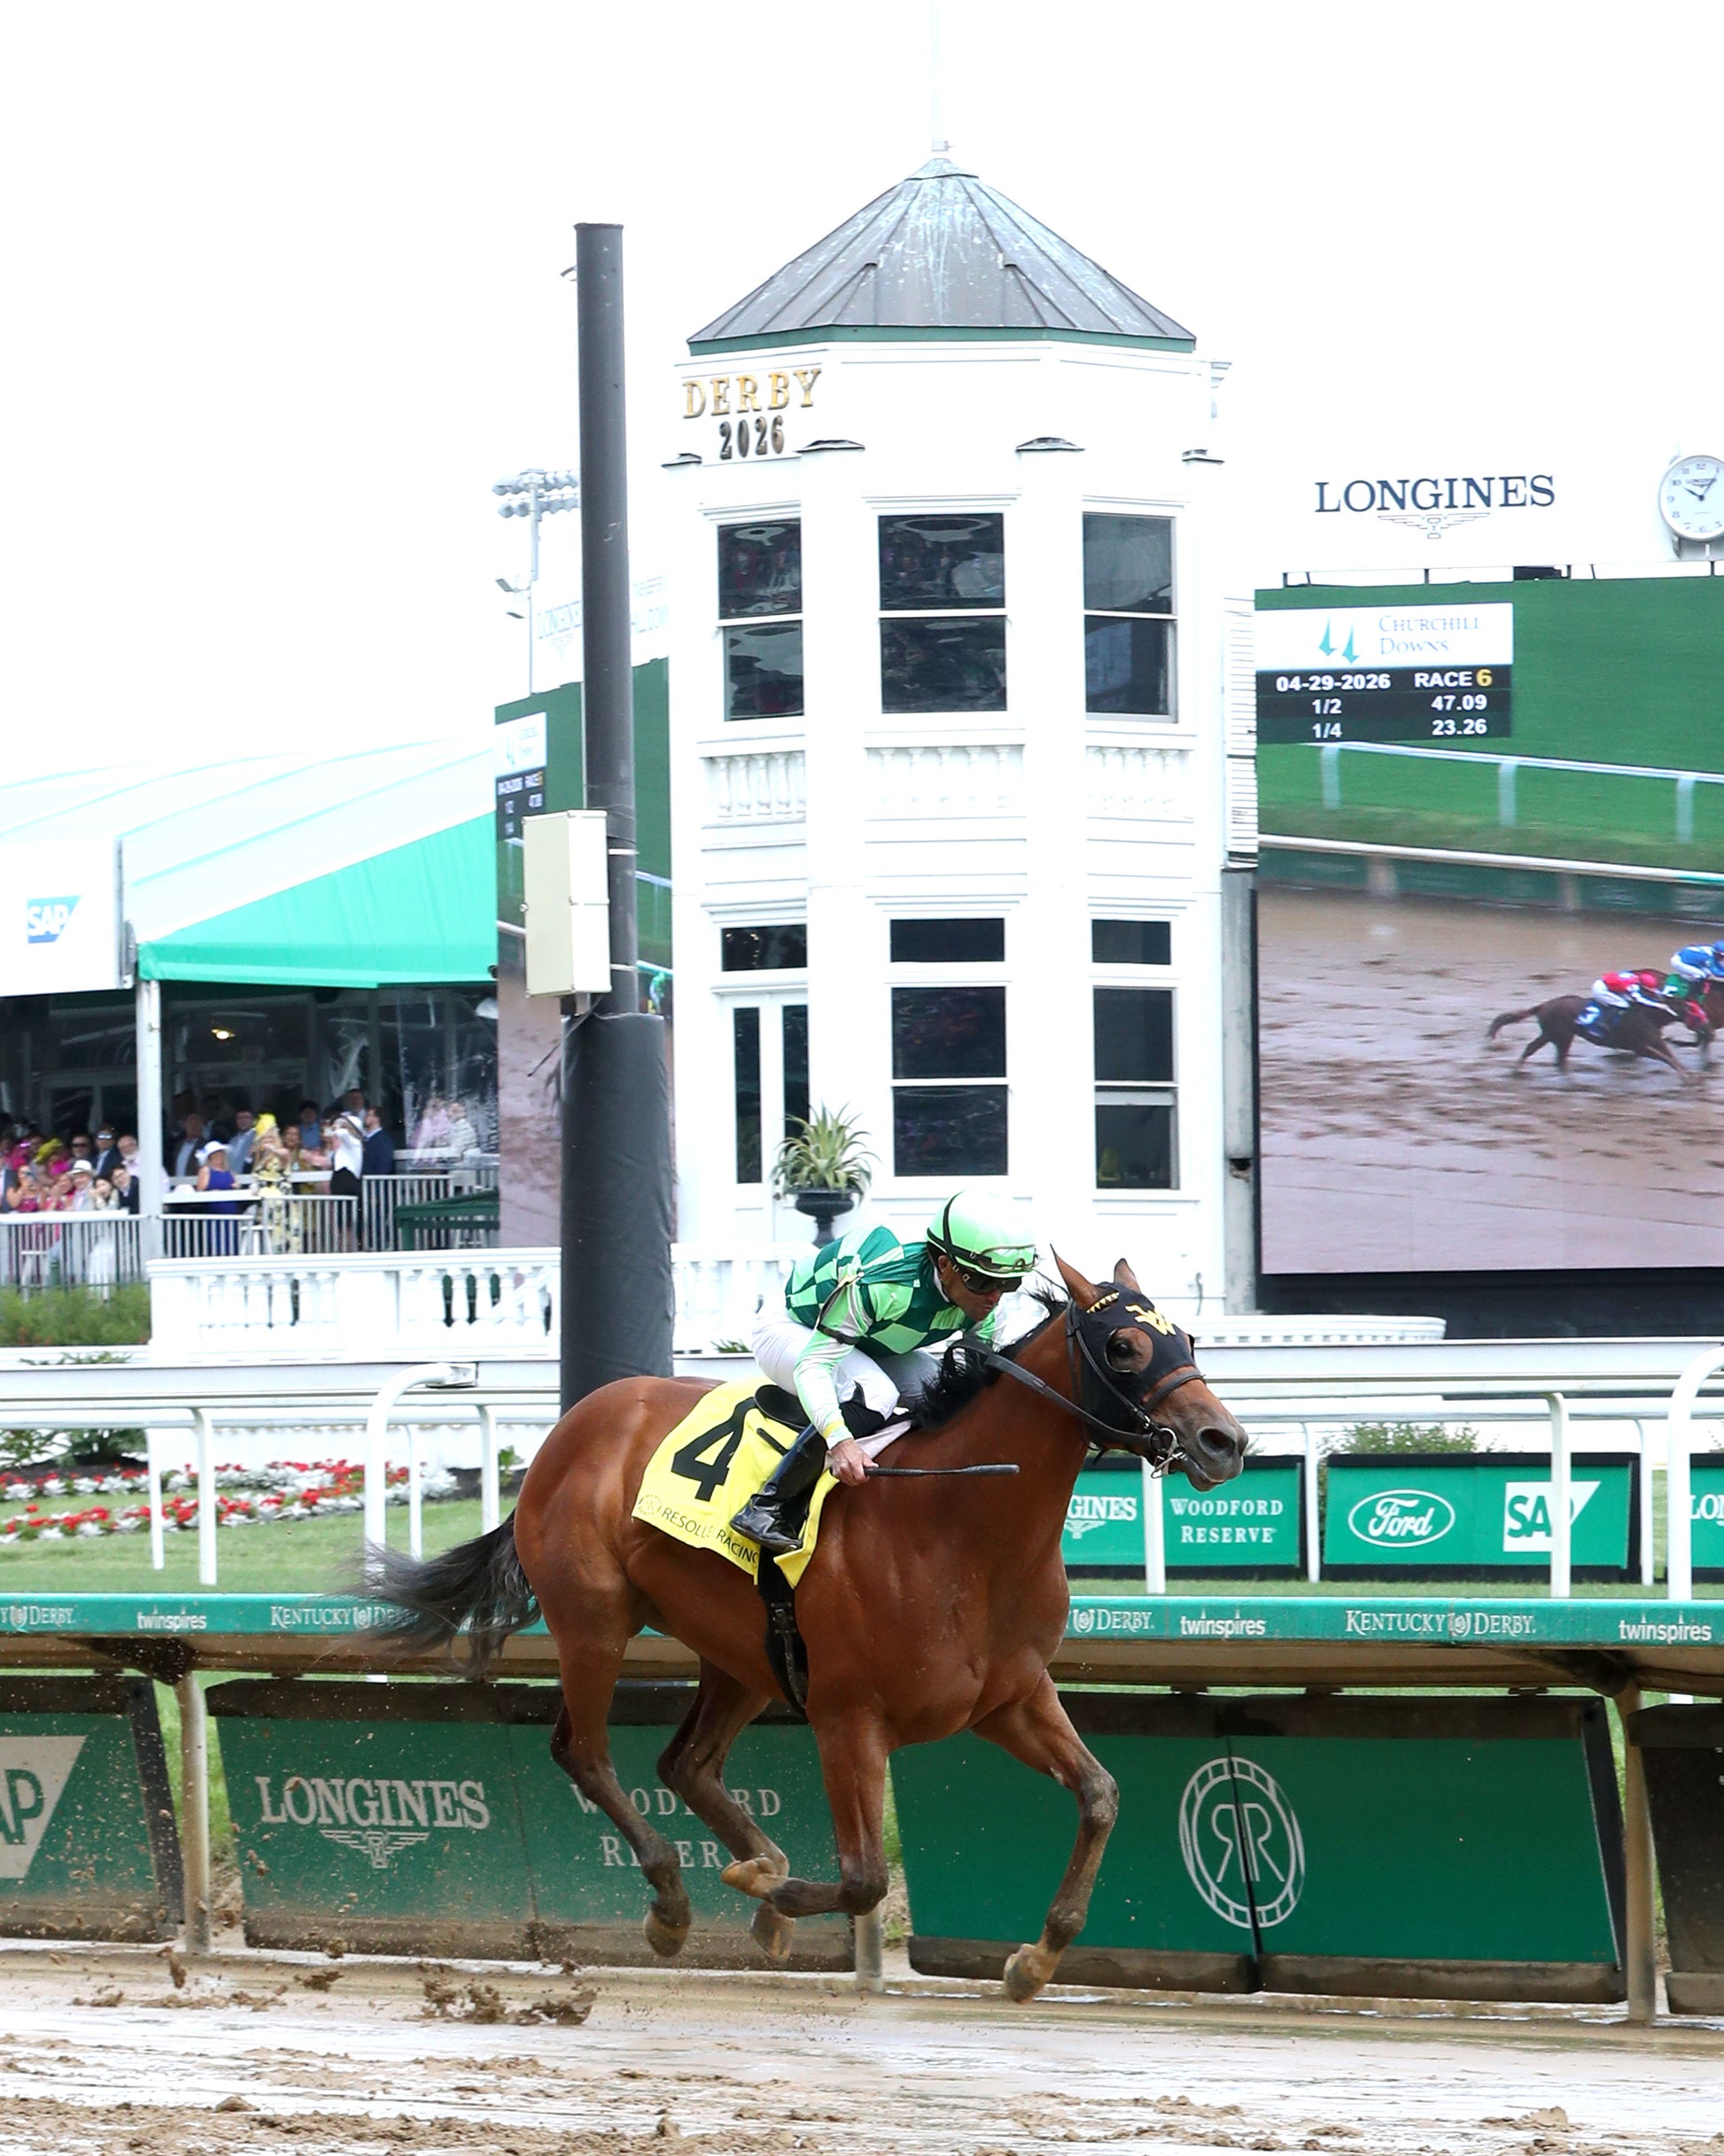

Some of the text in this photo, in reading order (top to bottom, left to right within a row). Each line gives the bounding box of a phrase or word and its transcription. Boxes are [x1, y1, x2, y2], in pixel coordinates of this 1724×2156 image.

[682, 368, 822, 419] DERBY
[718, 415, 785, 460] 2026
[1315, 474, 1556, 513] LONGINES
[1378, 615, 1481, 633] CHURCHILL
[1380, 637, 1449, 655] DOWNS
[1276, 668, 1494, 692] 04-29-2026 RACE 6
[1312, 694, 1488, 714] 1/2 47.09
[1312, 719, 1488, 738] 1/4 23.26
[27, 904, 69, 936] SAP
[671, 1396, 759, 1502] 4
[1067, 1494, 1138, 1522] GINES
[1170, 1498, 1284, 1516] WOODFORD
[1368, 1496, 1435, 1537] Ford
[1507, 1494, 1573, 1537] SA
[1181, 1525, 1274, 1544] RESERVE
[137, 1604, 207, 1631] twinspires
[270, 1606, 353, 1630] KENTUCKY
[1179, 1607, 1266, 1638] twinspires
[1345, 1609, 1446, 1636] KENTUCKY
[1619, 1613, 1712, 1645] twinspires
[255, 1777, 491, 1831] LONGINES
